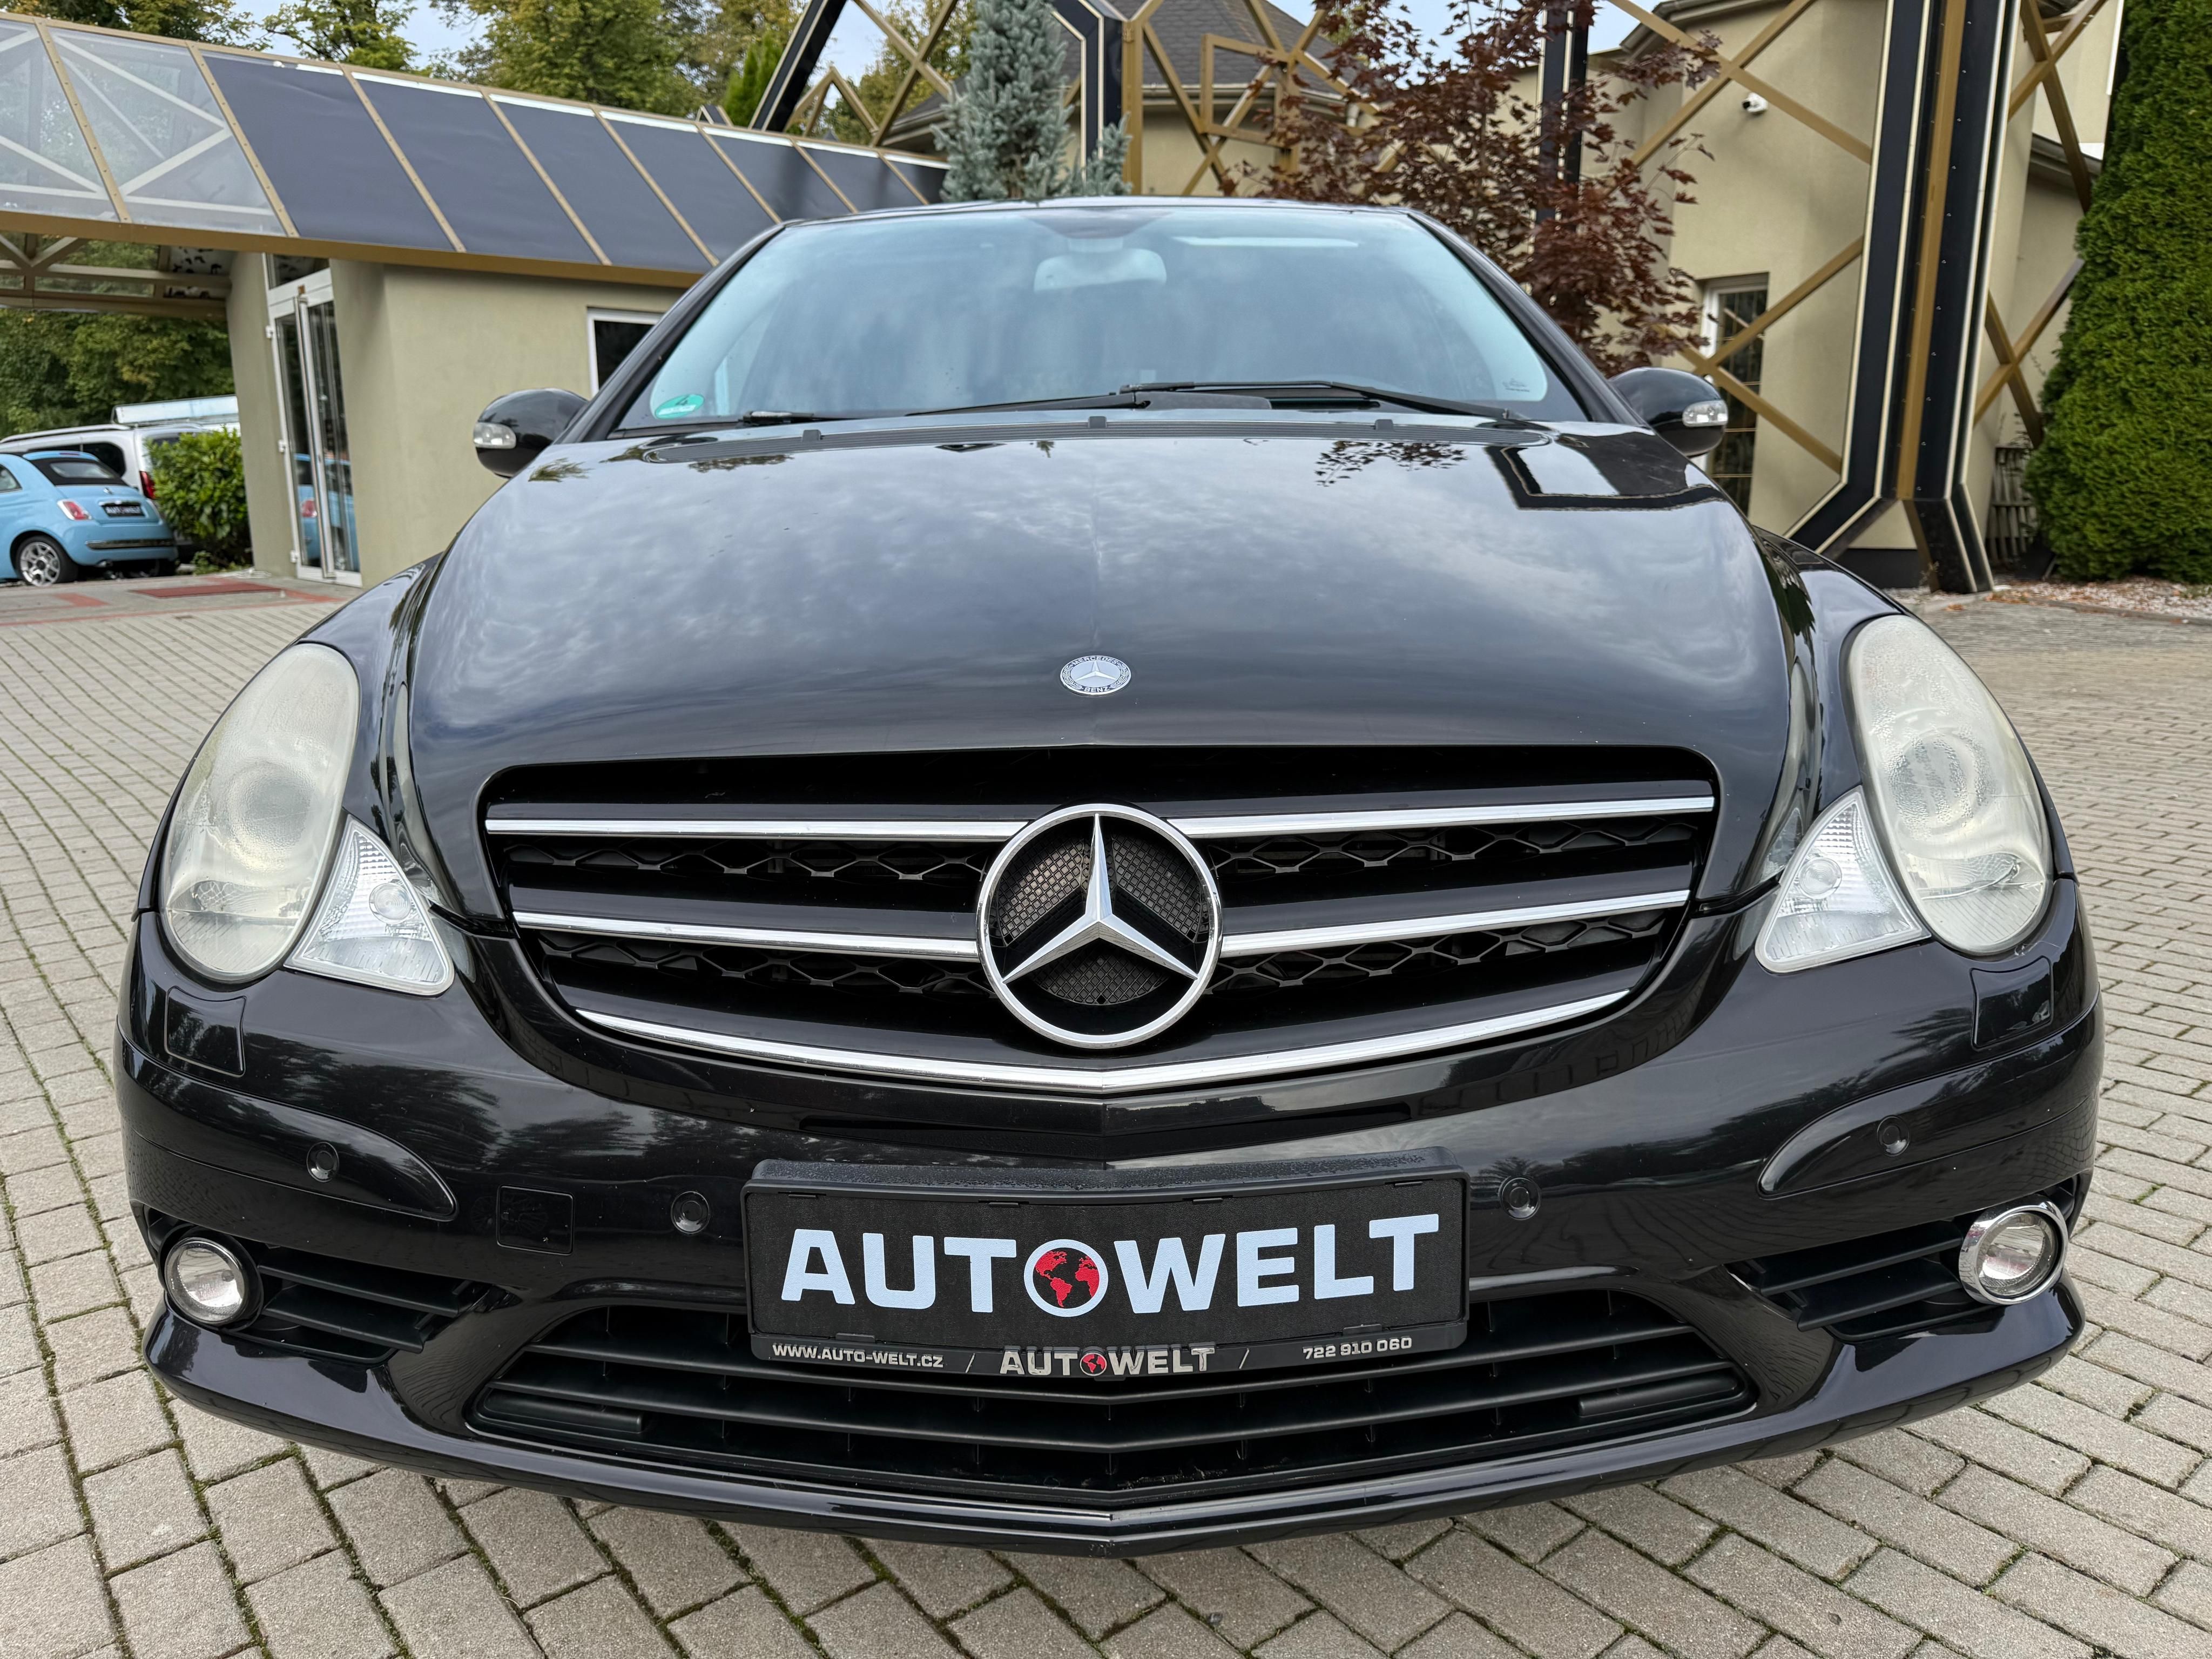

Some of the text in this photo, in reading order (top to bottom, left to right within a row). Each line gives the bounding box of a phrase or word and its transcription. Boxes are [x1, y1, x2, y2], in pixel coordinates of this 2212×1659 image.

[1071, 656, 1119, 665] MERCEDES
[780, 1213, 1440, 1317] AUTOWELT
[772, 1343, 944, 1368] WWW.AUTO-WELT.CZ
[1000, 1344, 1215, 1376] AUTOWELT
[1303, 1345, 1336, 1360] 722
[1340, 1341, 1372, 1356] 910
[1377, 1337, 1412, 1352] 060
